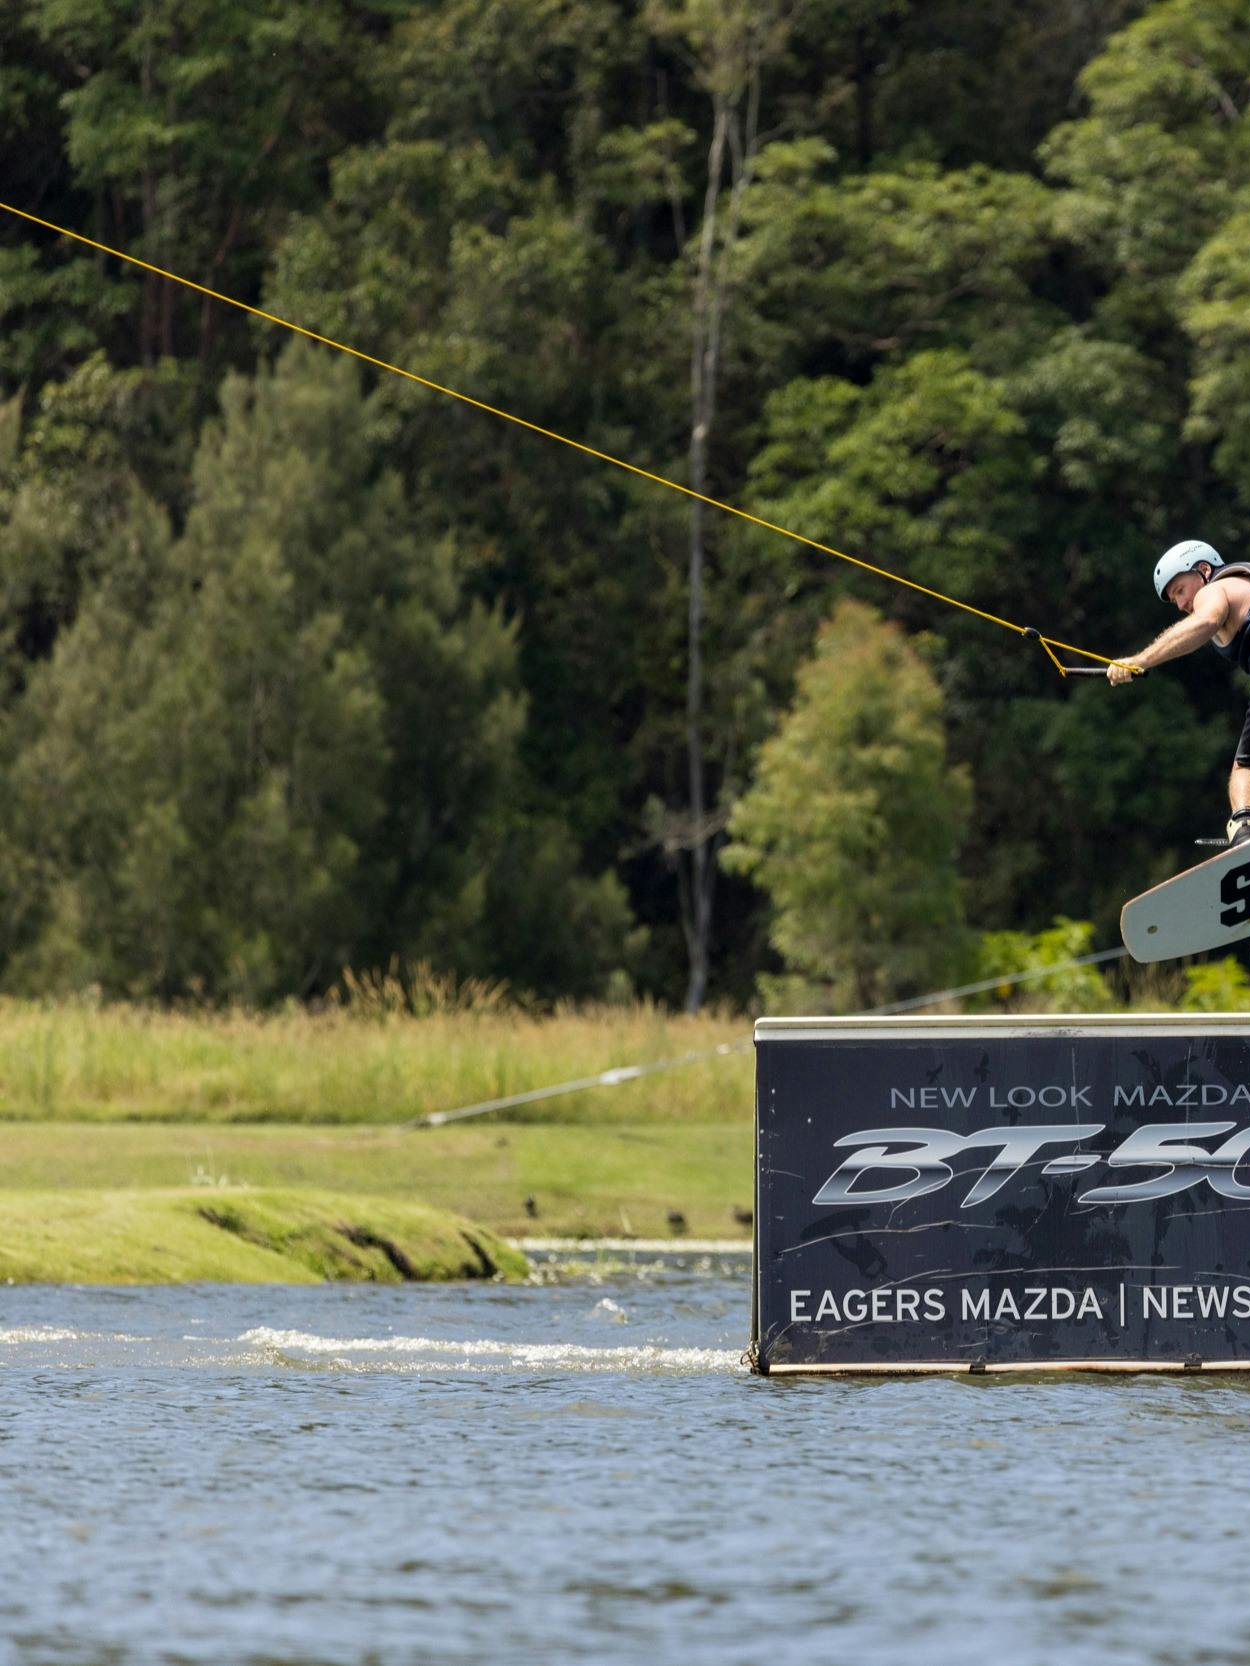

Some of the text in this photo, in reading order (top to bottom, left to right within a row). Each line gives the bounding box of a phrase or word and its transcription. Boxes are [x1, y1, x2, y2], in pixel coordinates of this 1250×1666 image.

[890, 1086, 977, 1109] NEW
[988, 1085, 1092, 1108] LOOK
[790, 1289, 946, 1322] EAGERS
[960, 1288, 1104, 1321] MAZDA
